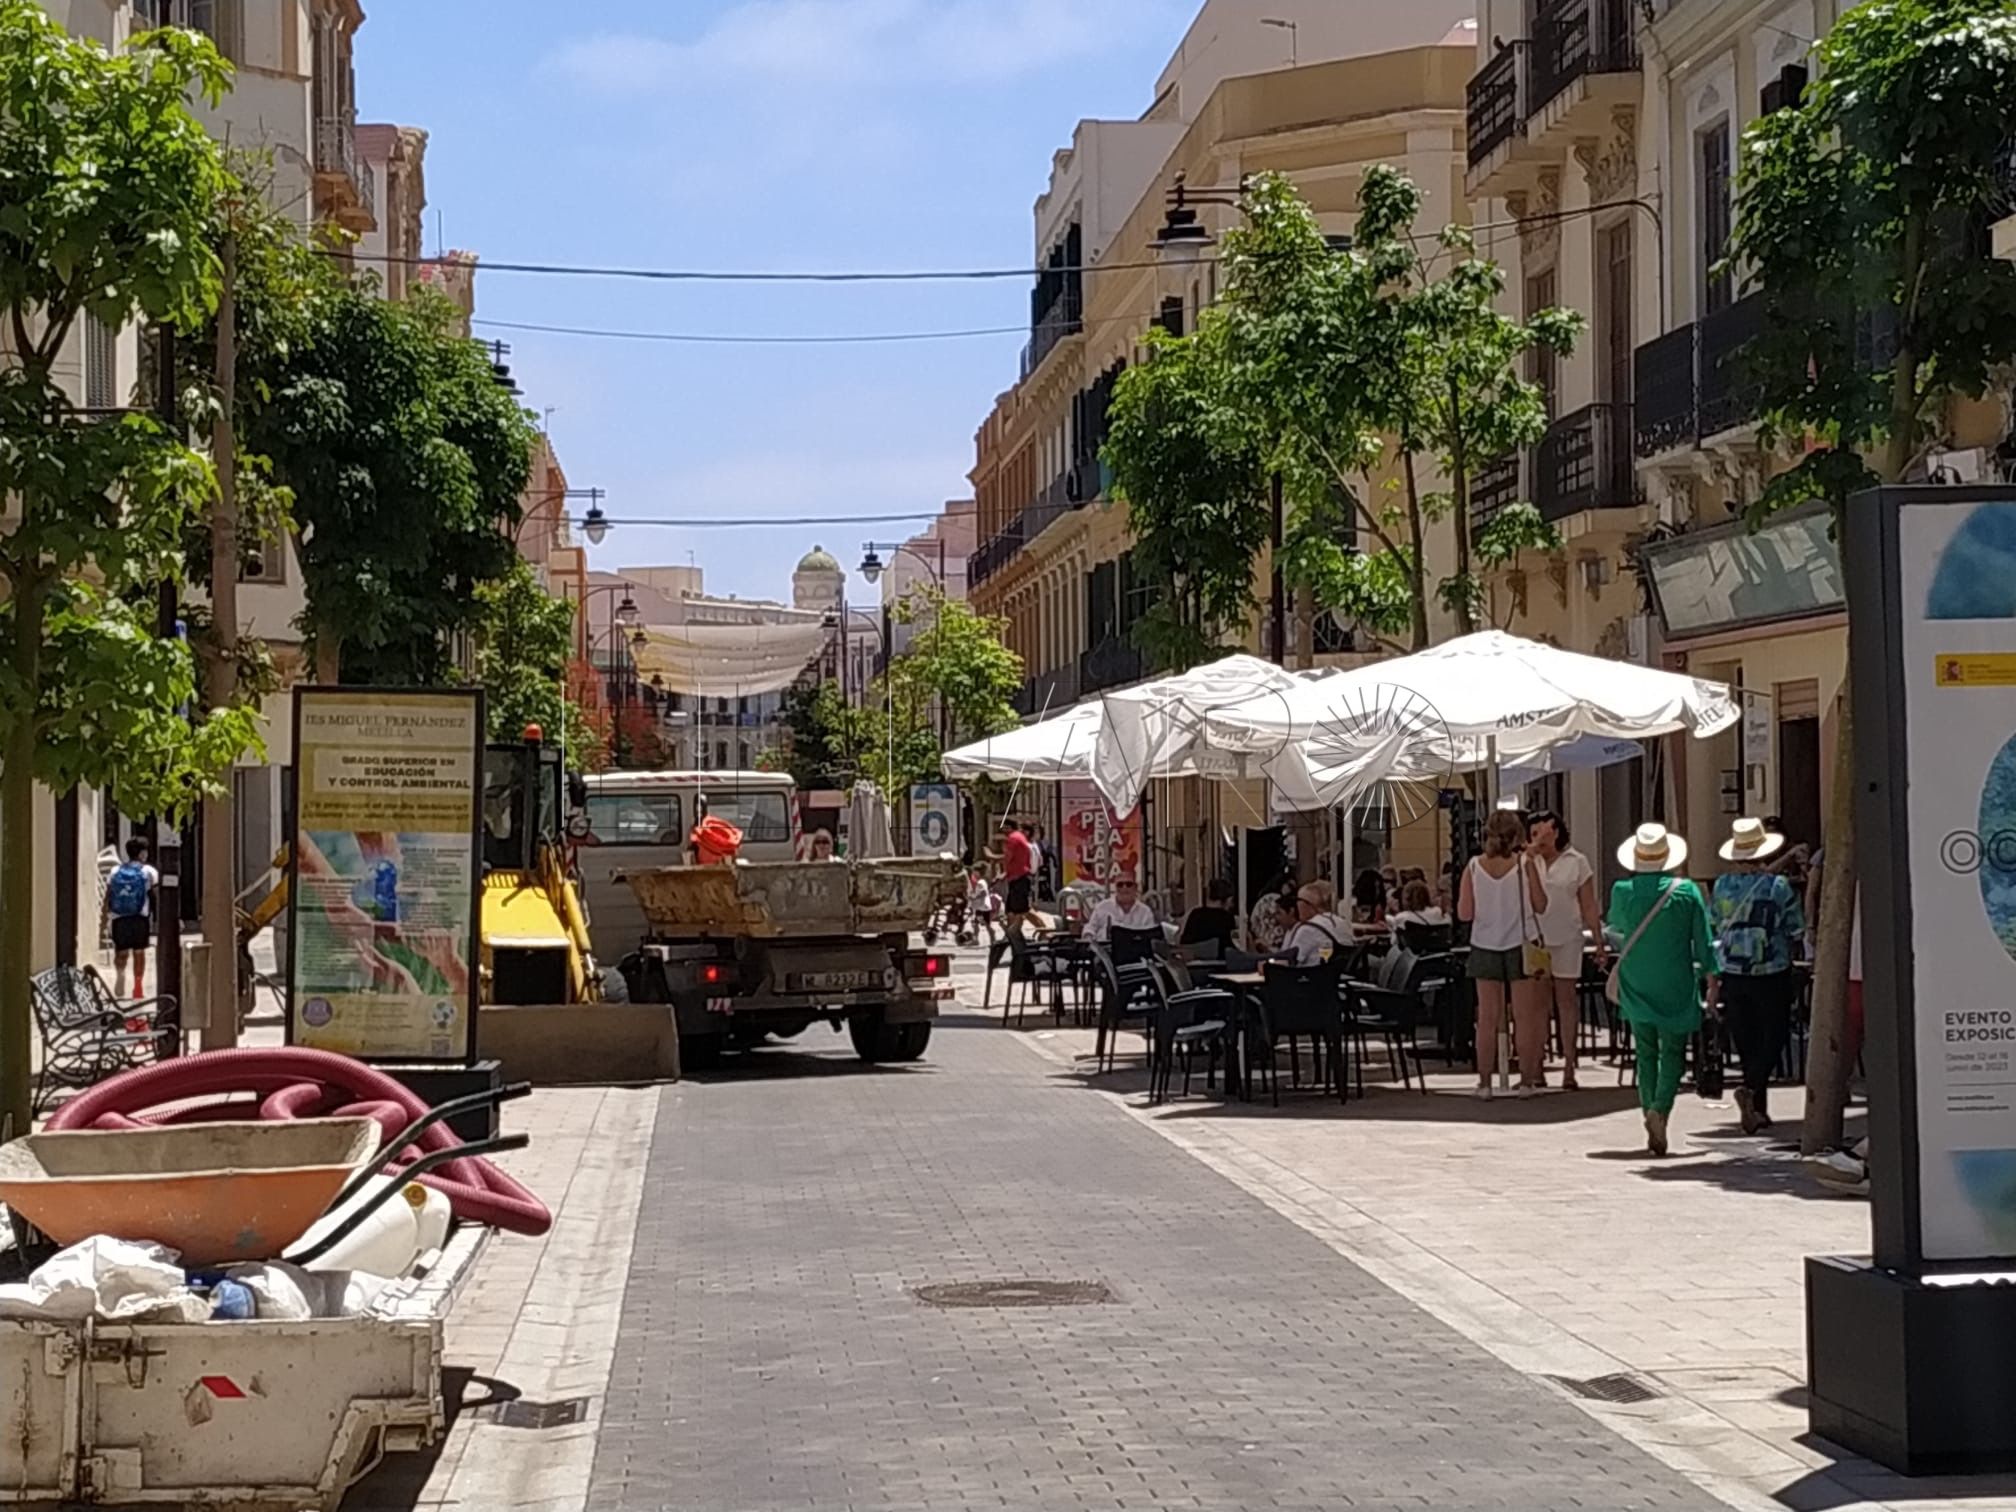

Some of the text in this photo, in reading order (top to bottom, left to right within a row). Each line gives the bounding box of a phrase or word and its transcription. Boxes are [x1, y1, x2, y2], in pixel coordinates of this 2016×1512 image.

[328, 713, 383, 727] MIGUEL
[341, 756, 456, 767] GRADO SUPERIOR EN
[364, 765, 436, 777] EDUCACIÓN
[327, 777, 471, 789] Y CONTROL AMBIENTAL
[1945, 1011, 2012, 1025] EVENTO
[1945, 1028, 2016, 1041] EXPOSIC
